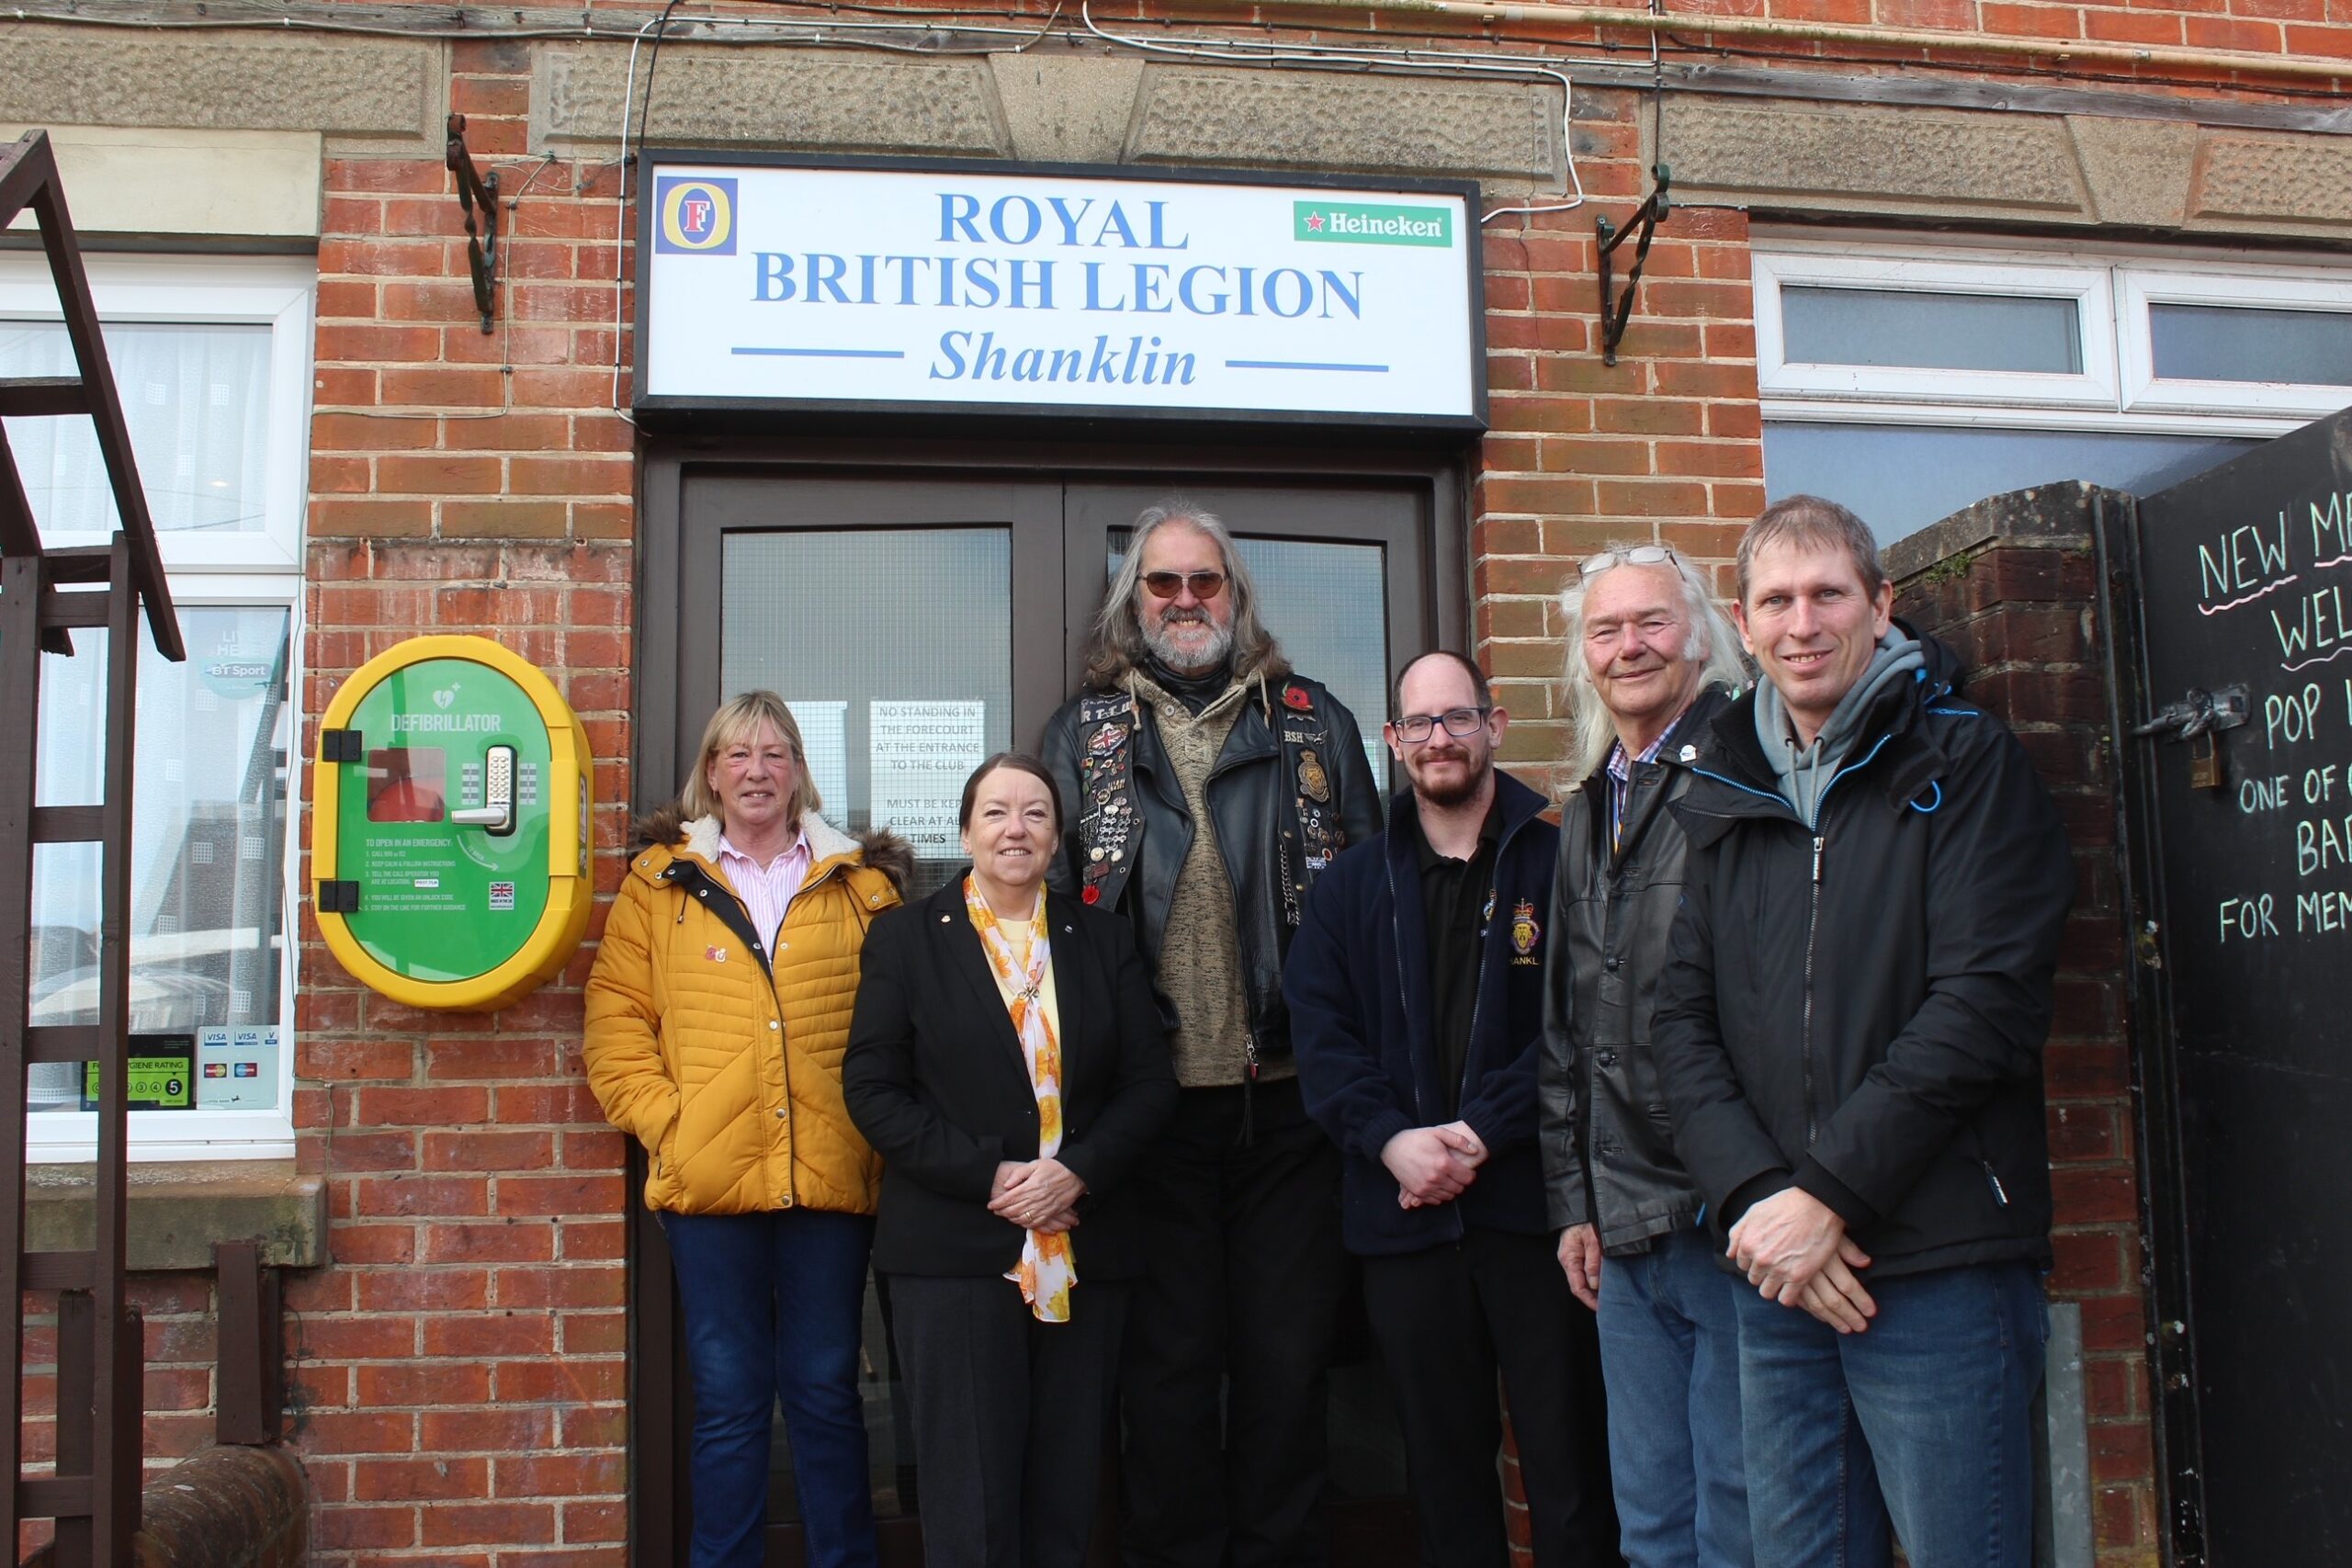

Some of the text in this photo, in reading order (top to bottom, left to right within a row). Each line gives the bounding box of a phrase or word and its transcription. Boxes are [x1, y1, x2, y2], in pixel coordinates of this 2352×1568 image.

[934, 193, 1189, 250] ROYAL
[1329, 212, 1442, 238] Heineken
[750, 252, 1364, 320] BRITISH LEGION
[929, 330, 1196, 386] Shanklin
[2199, 511, 2286, 598] NEW
[232, 665, 266, 677] Sport
[880, 706, 976, 717] NO STANDING IN
[2265, 682, 2320, 750] POP
[391, 714, 501, 731] DEFIBRILLATOR
[880, 725, 975, 735] THE FORECOURT
[876, 742, 979, 752] AT THE ENTRANCE
[891, 760, 965, 770] TO THE CLUB
[2240, 774, 2290, 814] ONE
[2304, 764, 2336, 804] OF
[887, 799, 962, 808] MUST BE KEP
[890, 816, 960, 826] CLEAR AT AL
[910, 833, 946, 844] TIMES
[2220, 893, 2278, 943] FOR
[1511, 957, 1539, 965] ANKL
[169, 1081, 179, 1094] 5
